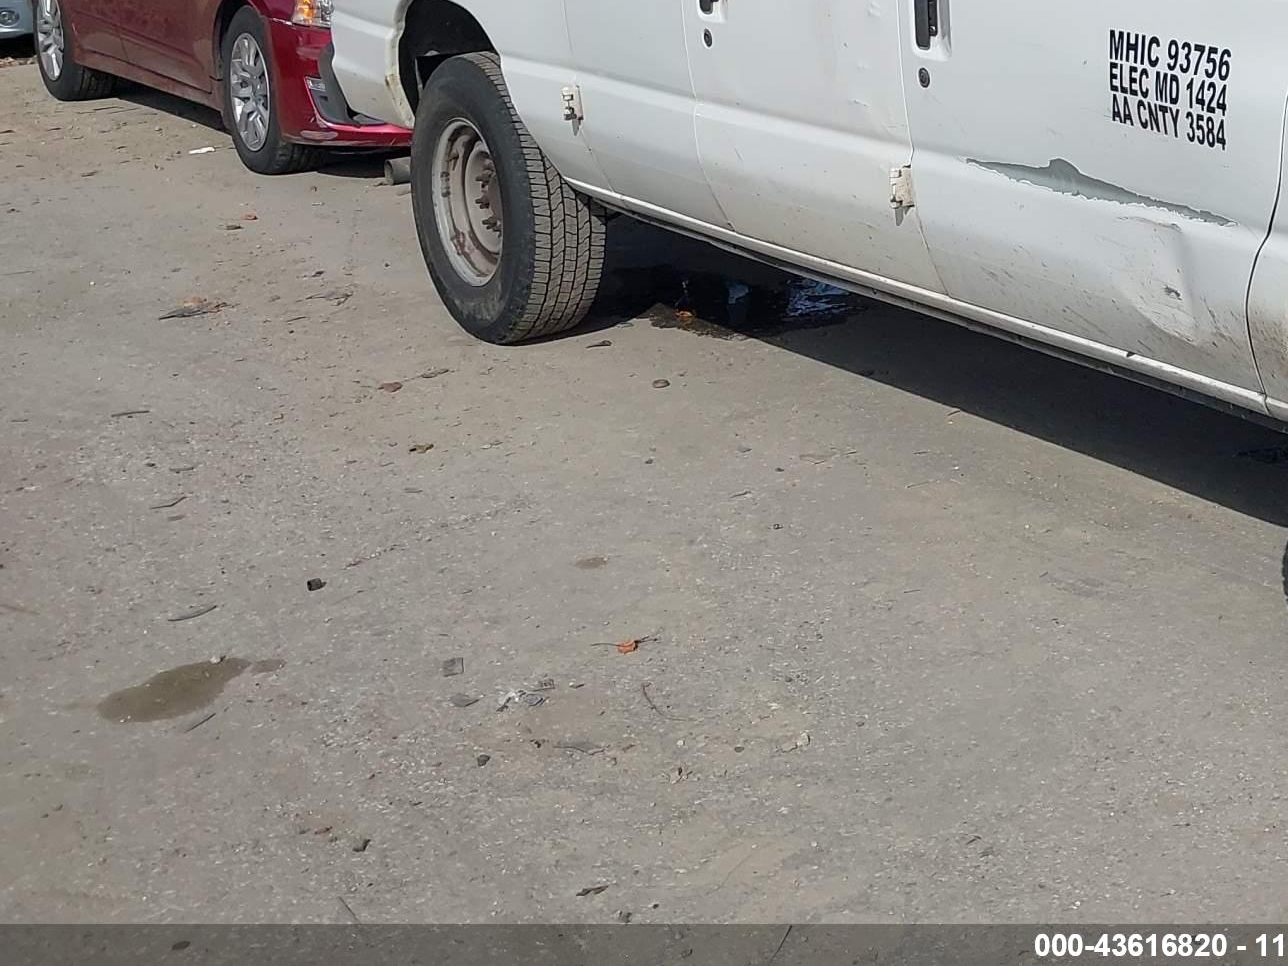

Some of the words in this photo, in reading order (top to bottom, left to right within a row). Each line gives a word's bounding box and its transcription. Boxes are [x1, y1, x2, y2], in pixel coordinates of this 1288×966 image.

[1109, 29, 1160, 67] MHIC
[1166, 39, 1232, 81] 93756
[1109, 62, 1149, 99] ELEC
[1155, 71, 1180, 105] MD
[1186, 77, 1227, 117] 1424
[1112, 93, 1134, 126] AA
[1137, 99, 1180, 138] CNTY
[1186, 111, 1227, 151] 3584
